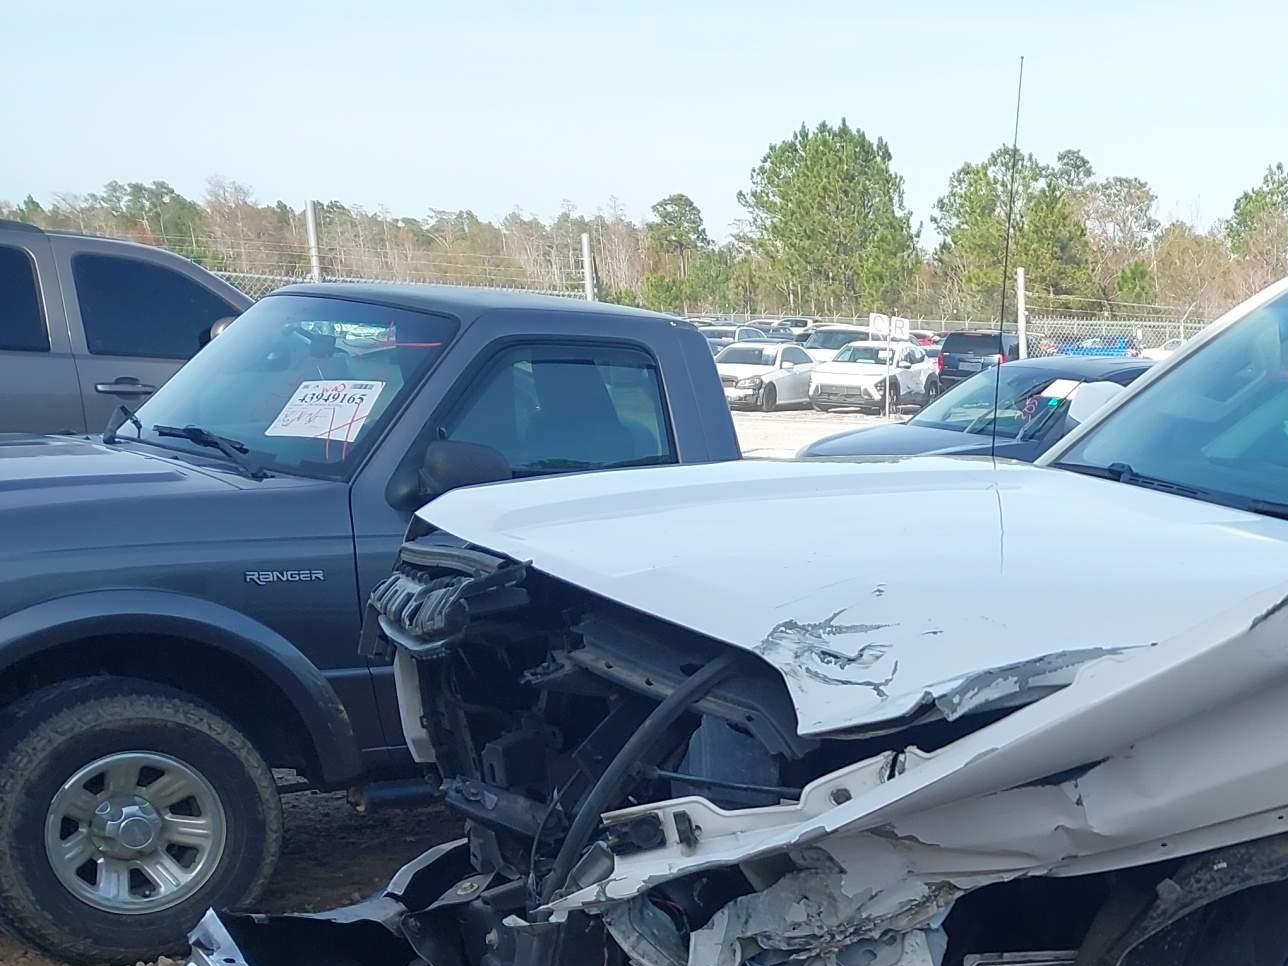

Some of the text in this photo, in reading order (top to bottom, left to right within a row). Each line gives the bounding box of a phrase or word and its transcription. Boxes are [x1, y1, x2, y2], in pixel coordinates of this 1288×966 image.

[894, 319, 905, 337] R
[298, 391, 368, 406] 43949165
[244, 570, 325, 585] RANGER
